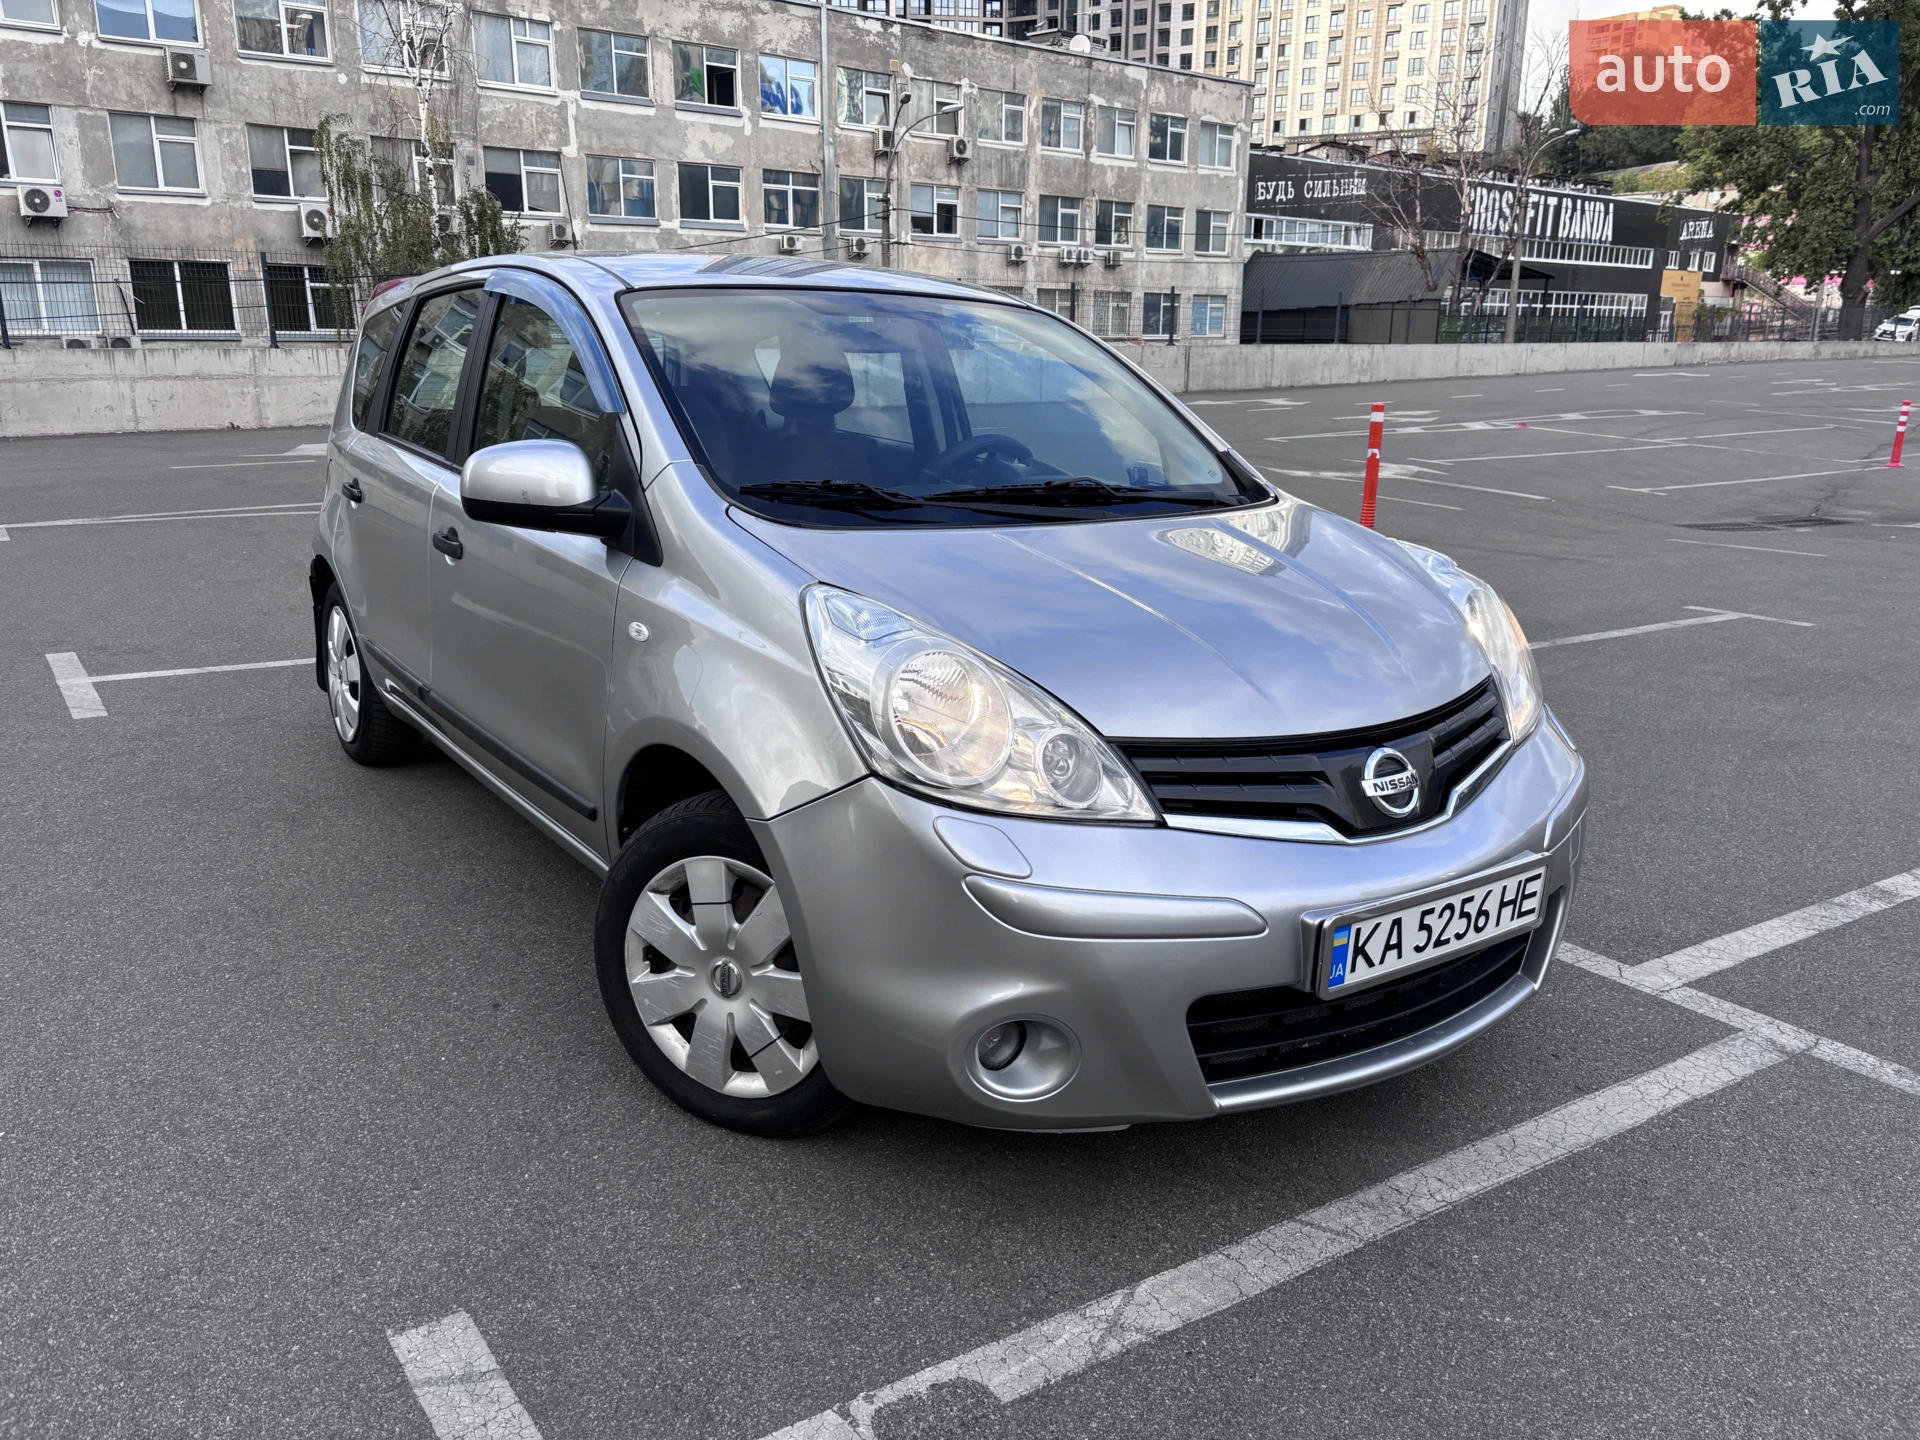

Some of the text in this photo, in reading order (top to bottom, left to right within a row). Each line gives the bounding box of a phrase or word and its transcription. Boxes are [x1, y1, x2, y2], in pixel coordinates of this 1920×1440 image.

[1256, 180, 1295, 202] БУДЬ
[1557, 197, 1615, 243] BANDA
[1679, 220, 1715, 241] ARENA
[1372, 772, 1419, 793] NISSAN
[1349, 872, 1543, 974] KA 5256 HE
